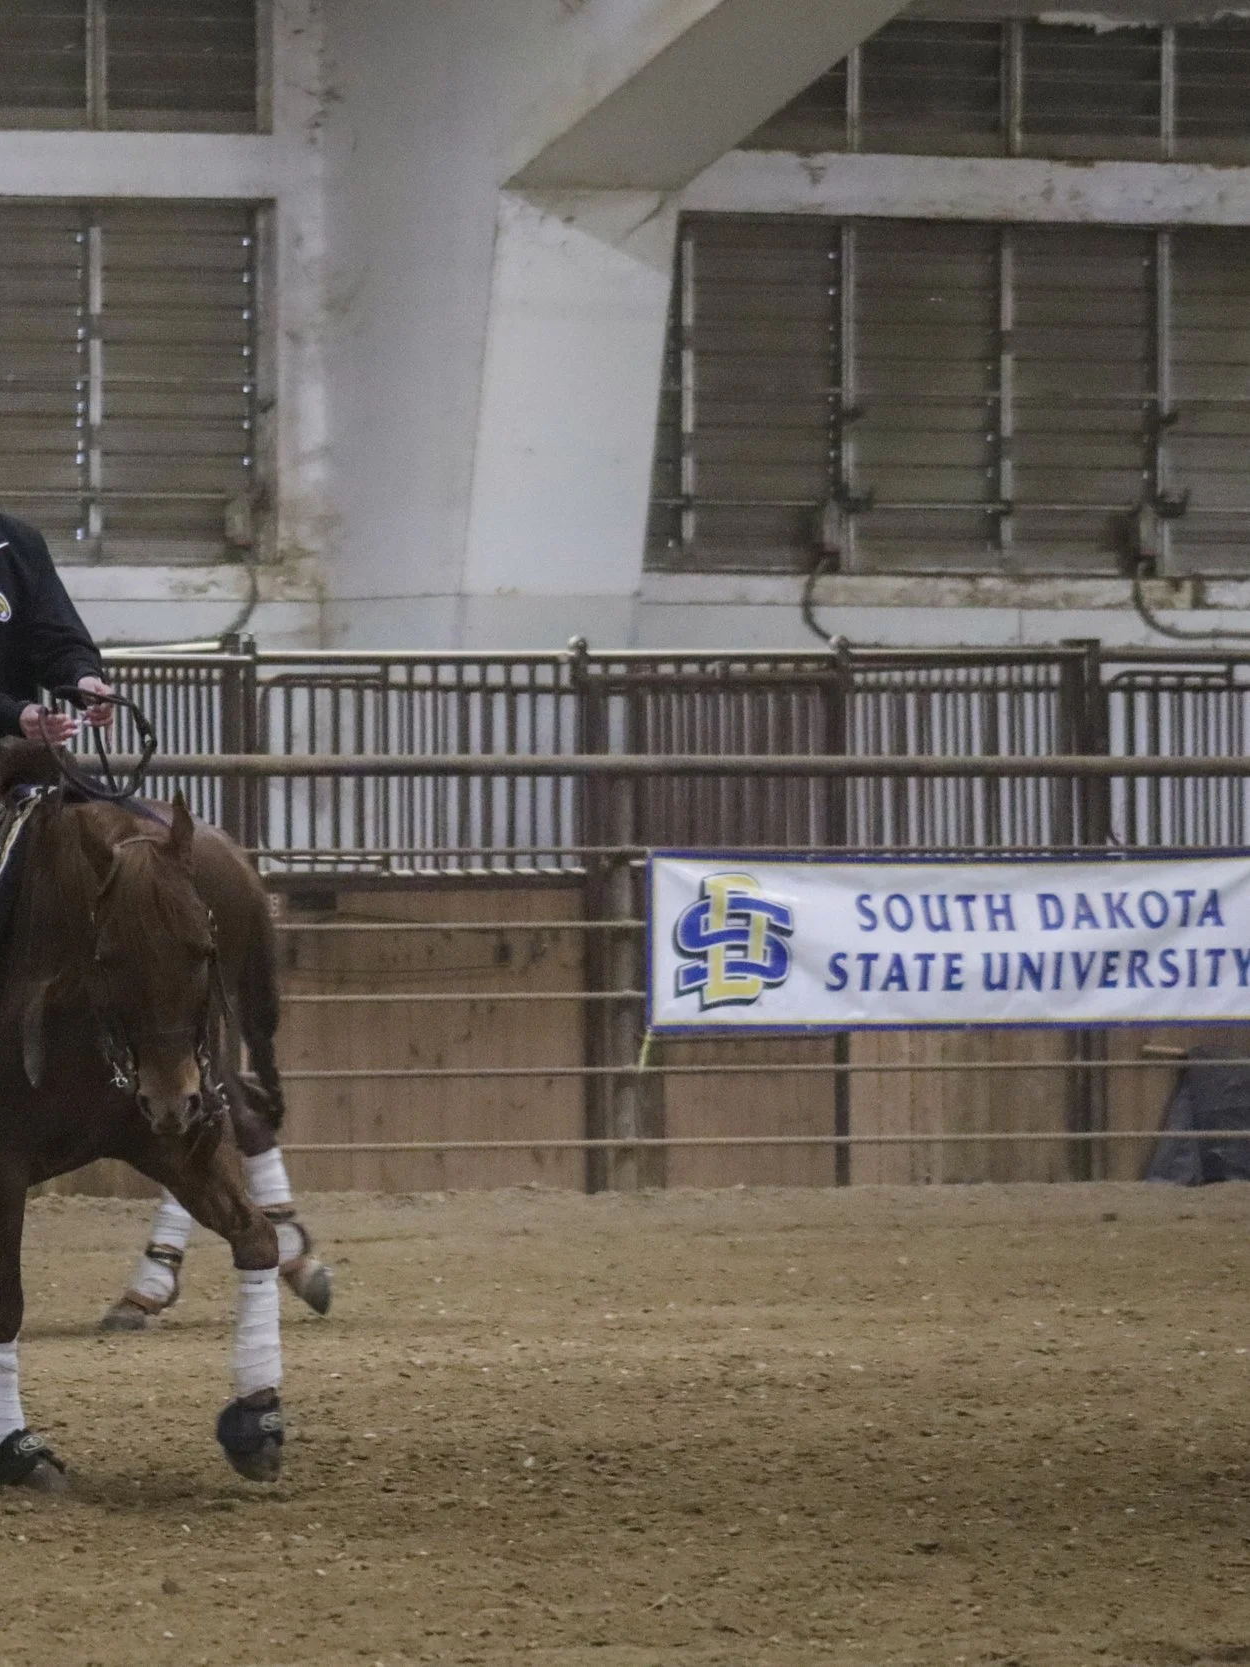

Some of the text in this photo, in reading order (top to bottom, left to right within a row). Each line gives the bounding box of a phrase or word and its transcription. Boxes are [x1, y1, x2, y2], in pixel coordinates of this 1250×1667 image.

[854, 888, 1225, 933] SOUTH DAKOTA
[825, 948, 1250, 992] STATE UNIVERSITY
